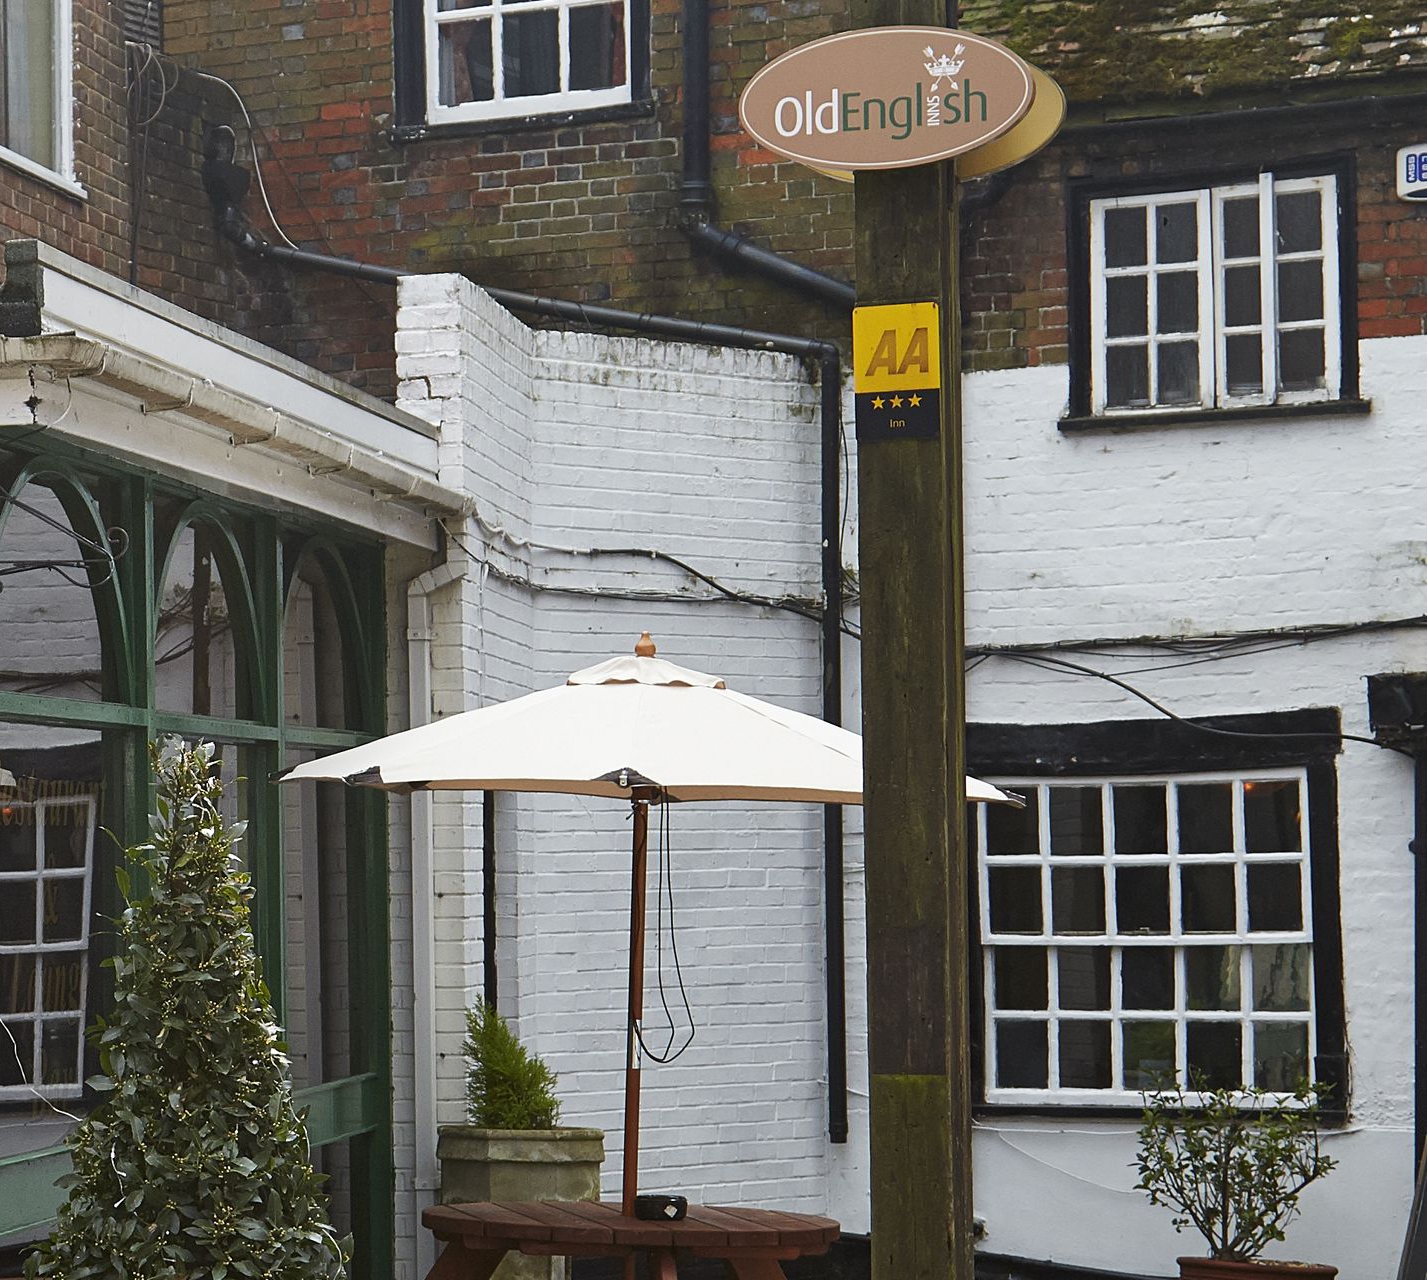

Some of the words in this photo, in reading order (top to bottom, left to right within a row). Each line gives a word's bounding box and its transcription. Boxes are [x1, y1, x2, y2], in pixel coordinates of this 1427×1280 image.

[926, 94, 941, 127] INNS
[864, 327, 929, 377] AA
[889, 419, 906, 428] Inn
